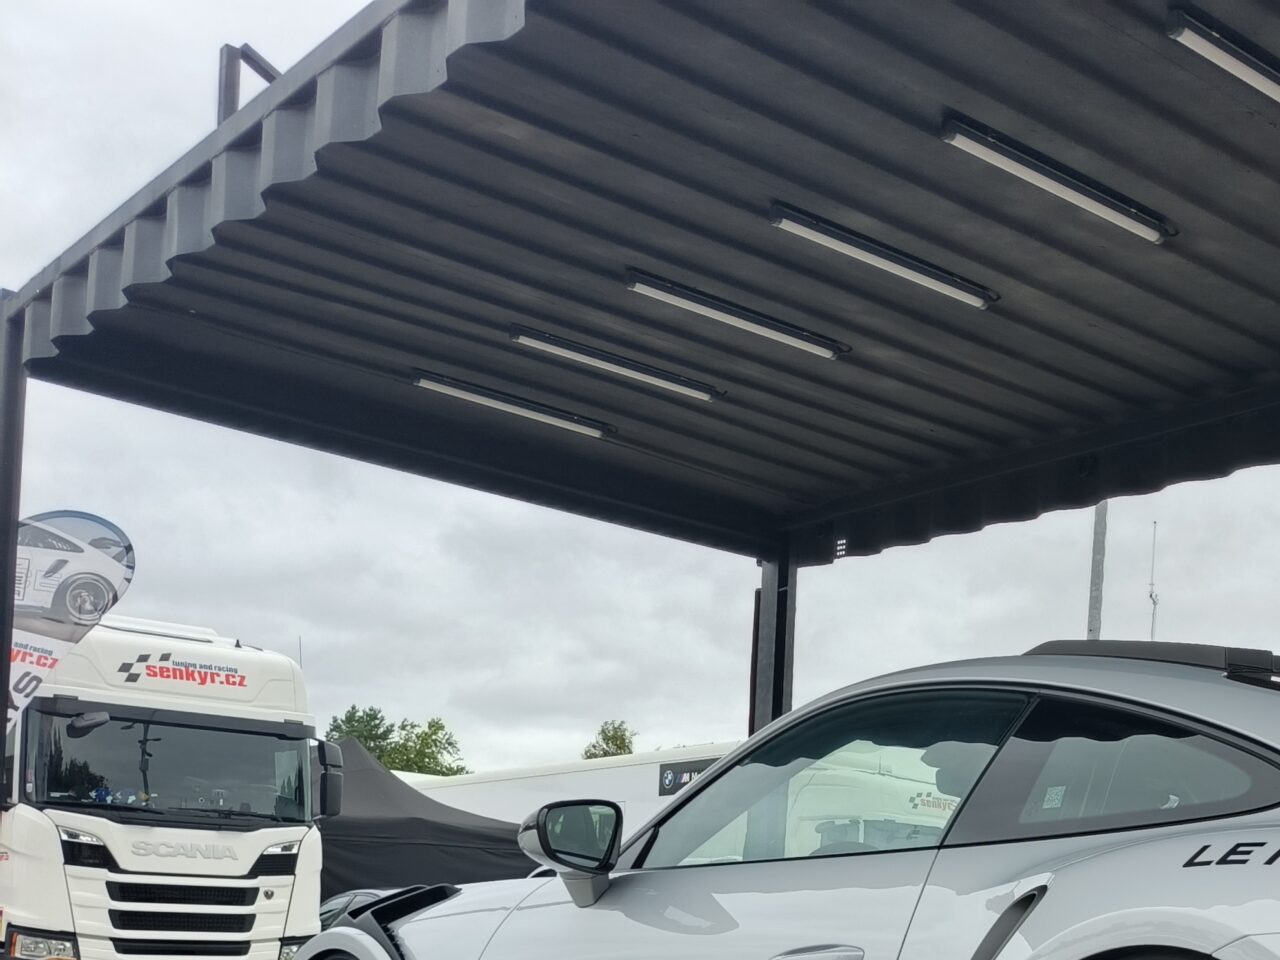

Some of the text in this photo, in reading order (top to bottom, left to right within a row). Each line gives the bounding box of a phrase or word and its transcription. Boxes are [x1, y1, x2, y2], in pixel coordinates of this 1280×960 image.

[145, 664, 247, 687] senkyr.cz
[172, 660, 238, 674] tuning and racing
[131, 840, 239, 861] SCANIA
[1182, 842, 1268, 868] LE
